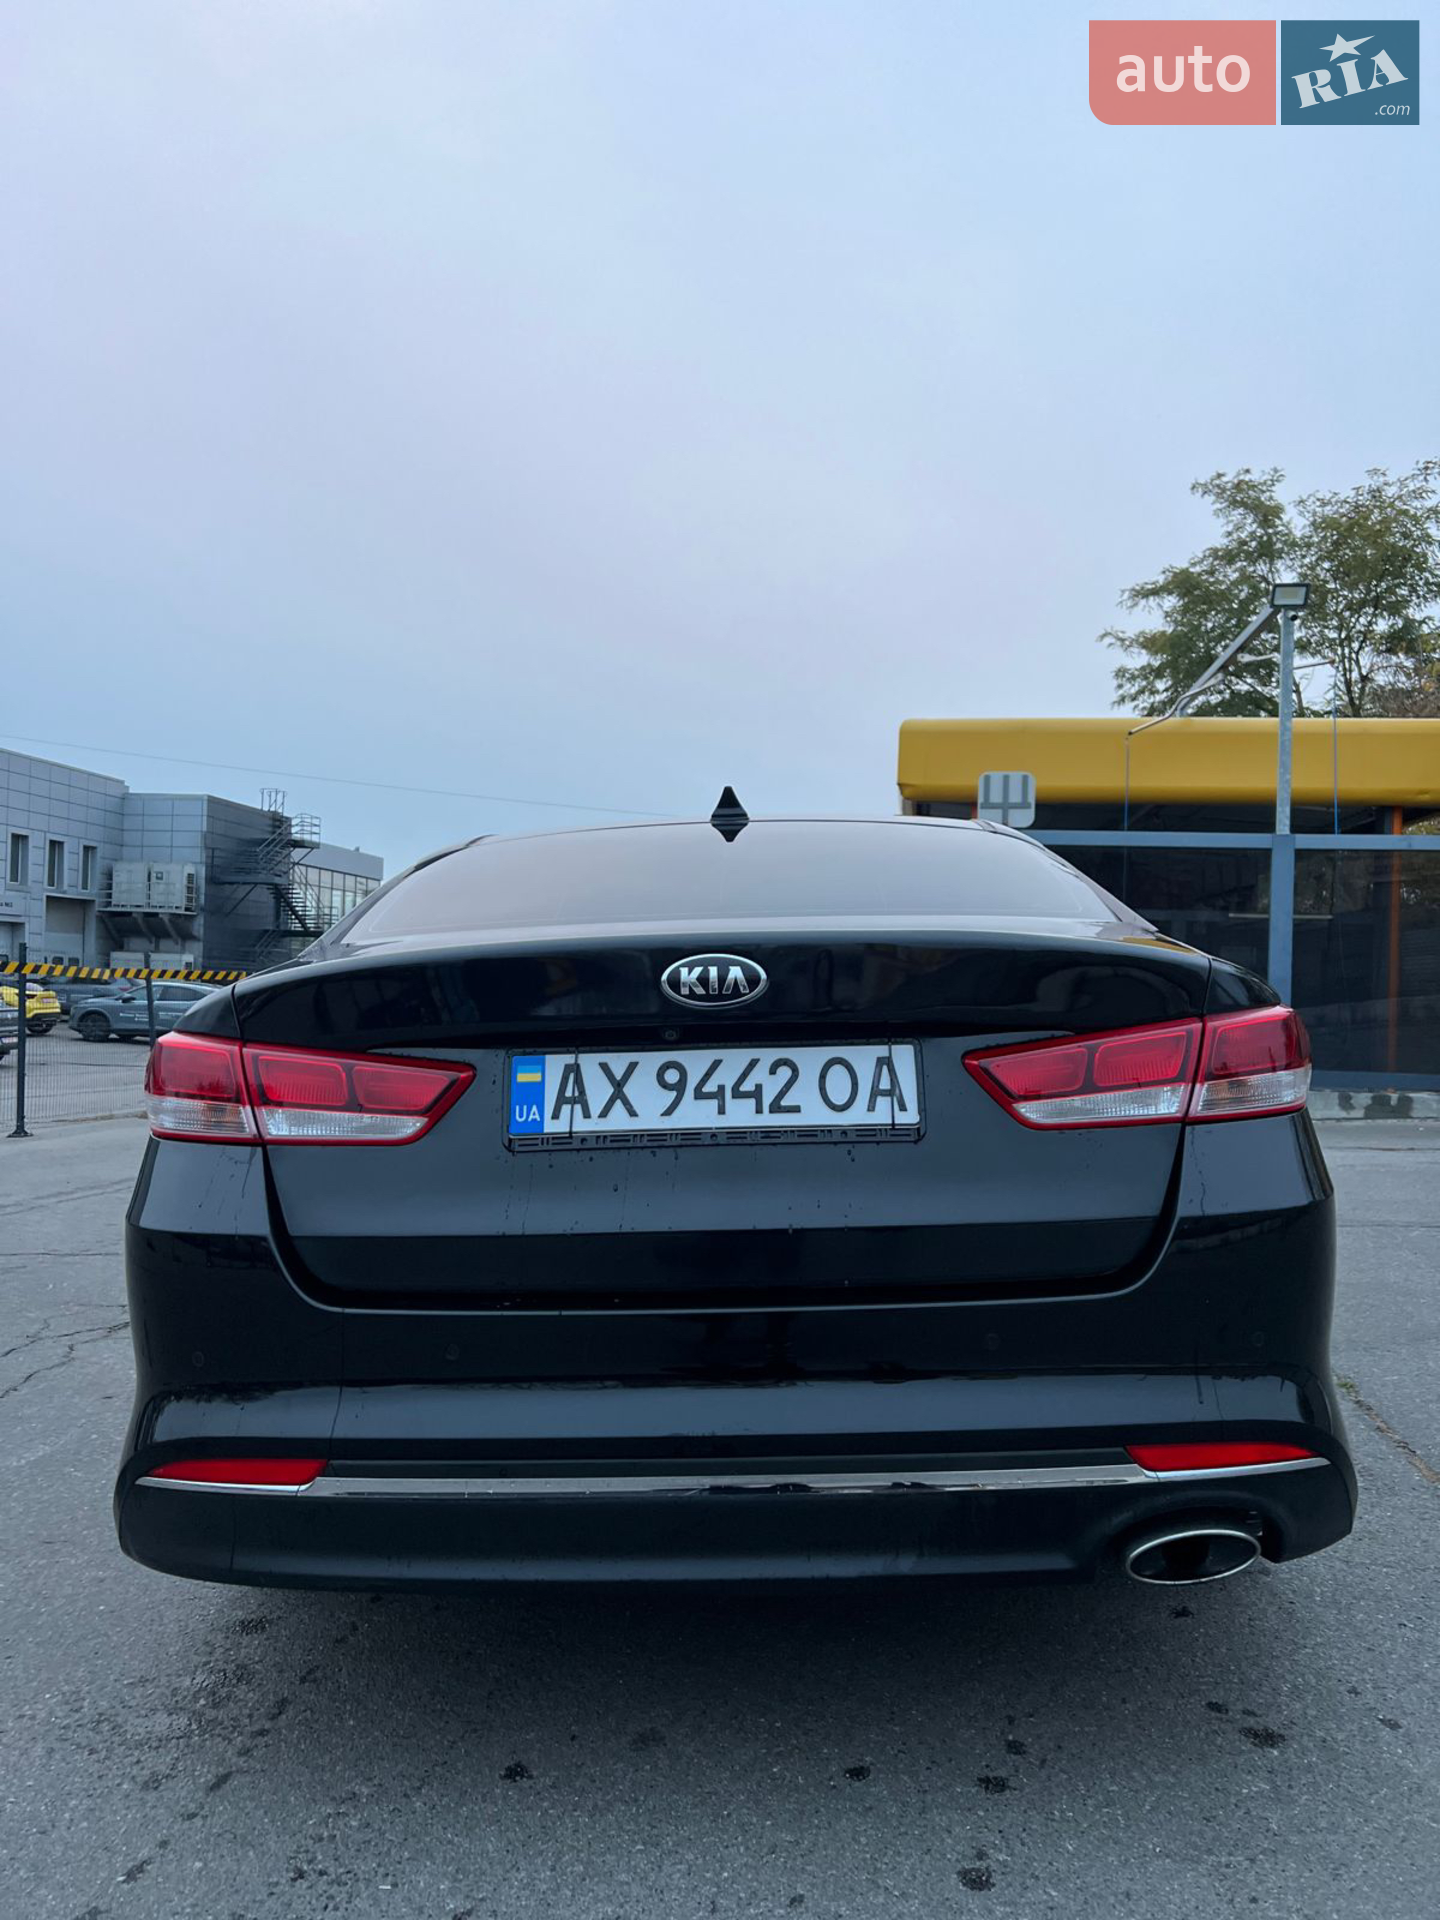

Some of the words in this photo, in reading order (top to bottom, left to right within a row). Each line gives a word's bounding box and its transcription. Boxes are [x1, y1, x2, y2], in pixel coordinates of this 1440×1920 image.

[679, 965, 750, 995] KIA
[551, 1061, 639, 1120] AX
[656, 1057, 801, 1117] 9442
[818, 1056, 908, 1112] OA
[515, 1104, 541, 1122] UA
